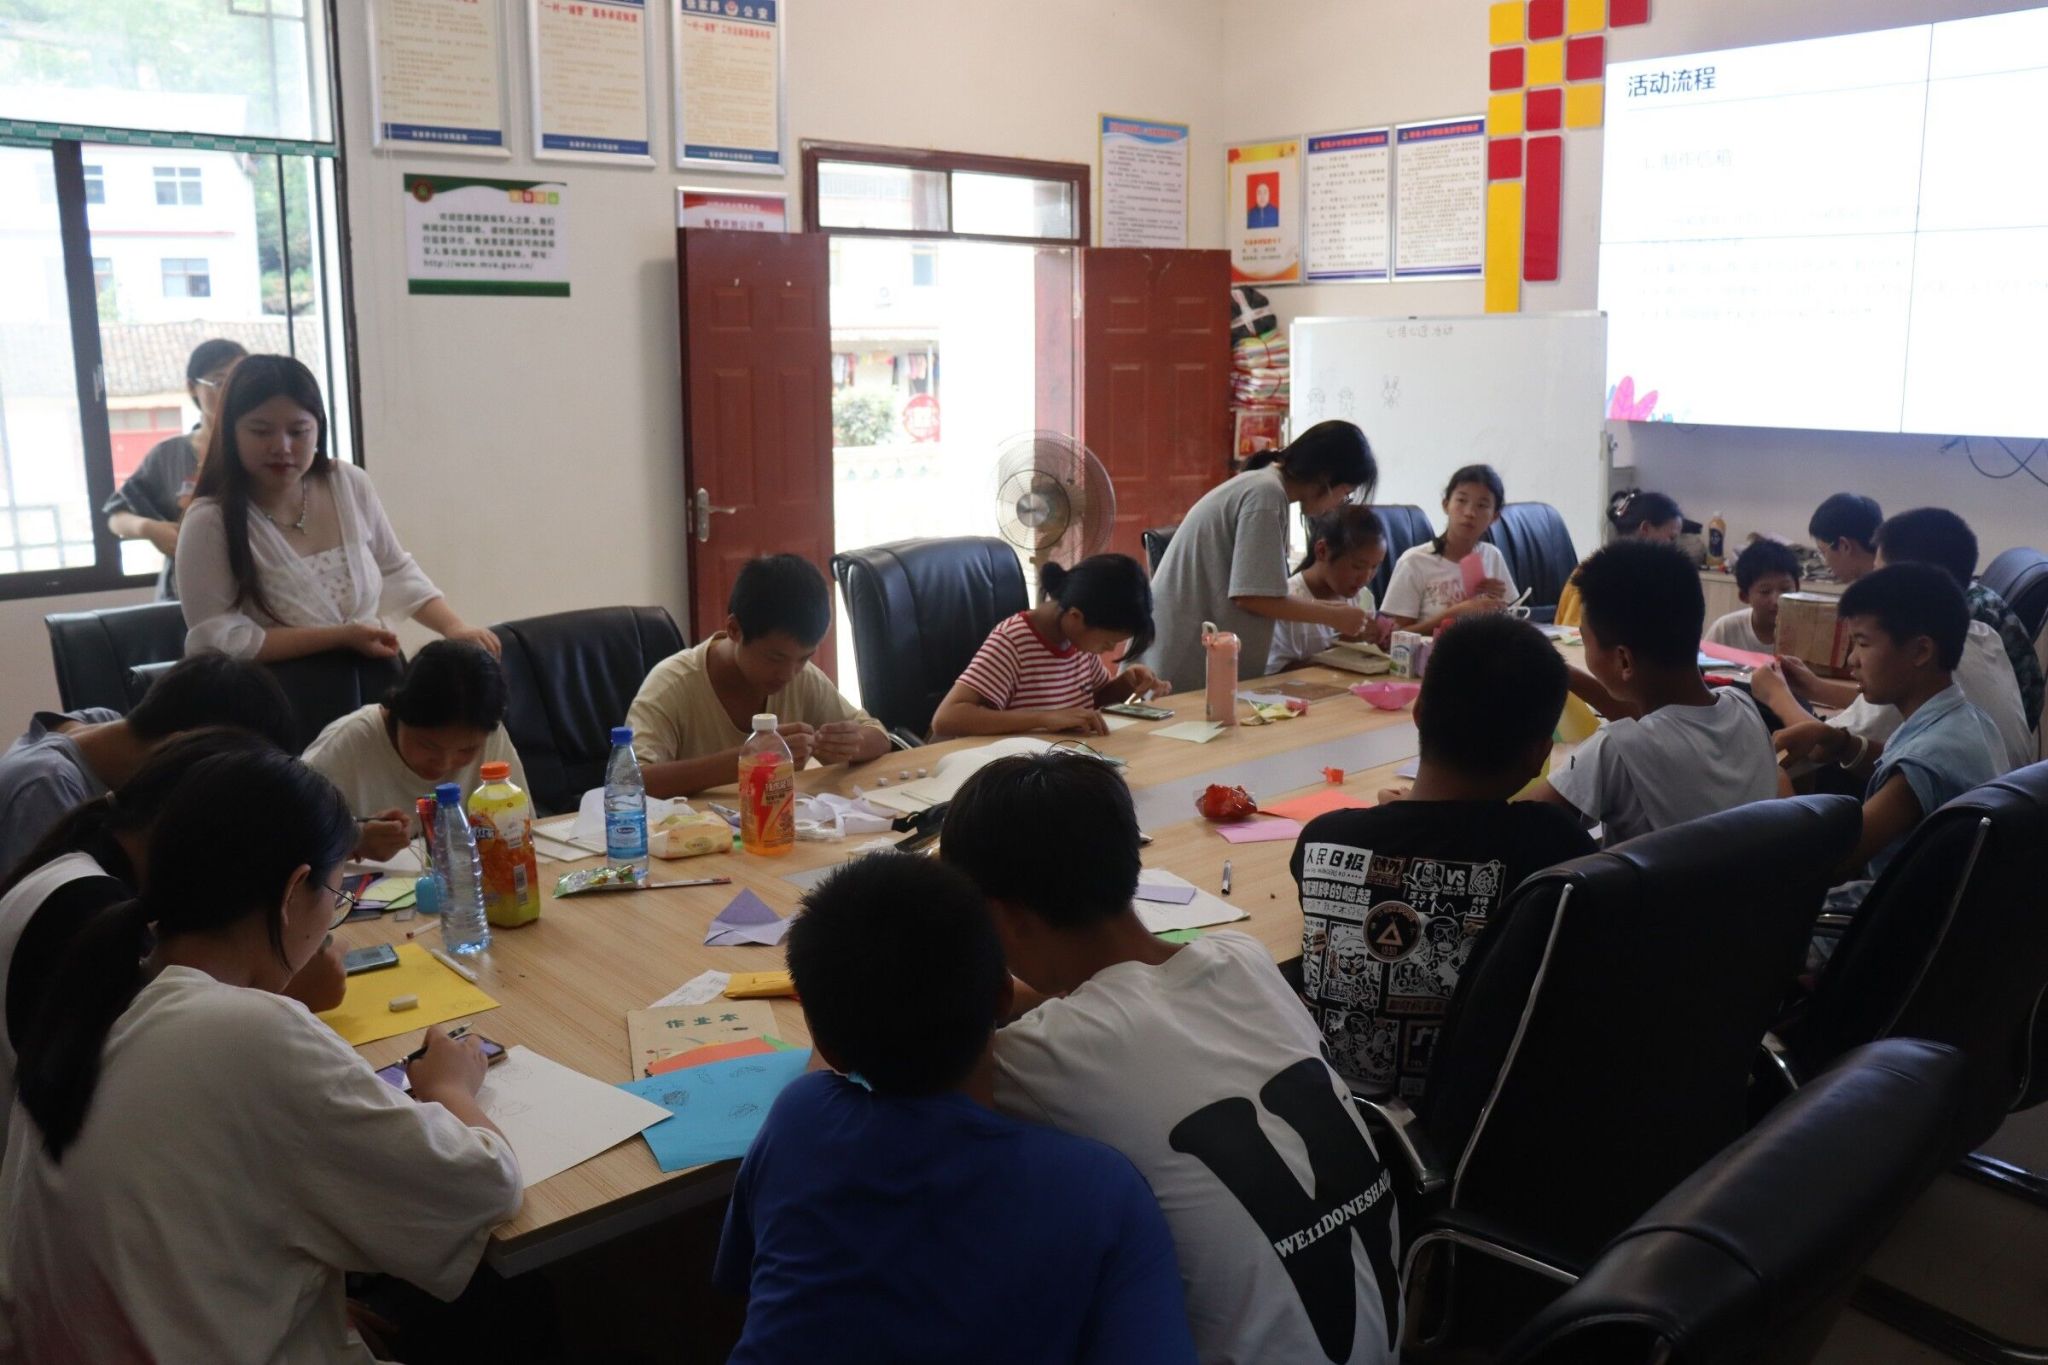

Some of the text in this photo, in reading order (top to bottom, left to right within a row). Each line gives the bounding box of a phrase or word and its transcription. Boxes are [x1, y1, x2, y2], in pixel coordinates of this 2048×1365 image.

[1628, 66, 1716, 97] 活动流程
[1307, 848, 1366, 872] 人民日报
[1447, 869, 1465, 886] VS
[1470, 906, 1488, 915] DS
[665, 1013, 739, 1029] 作业本
